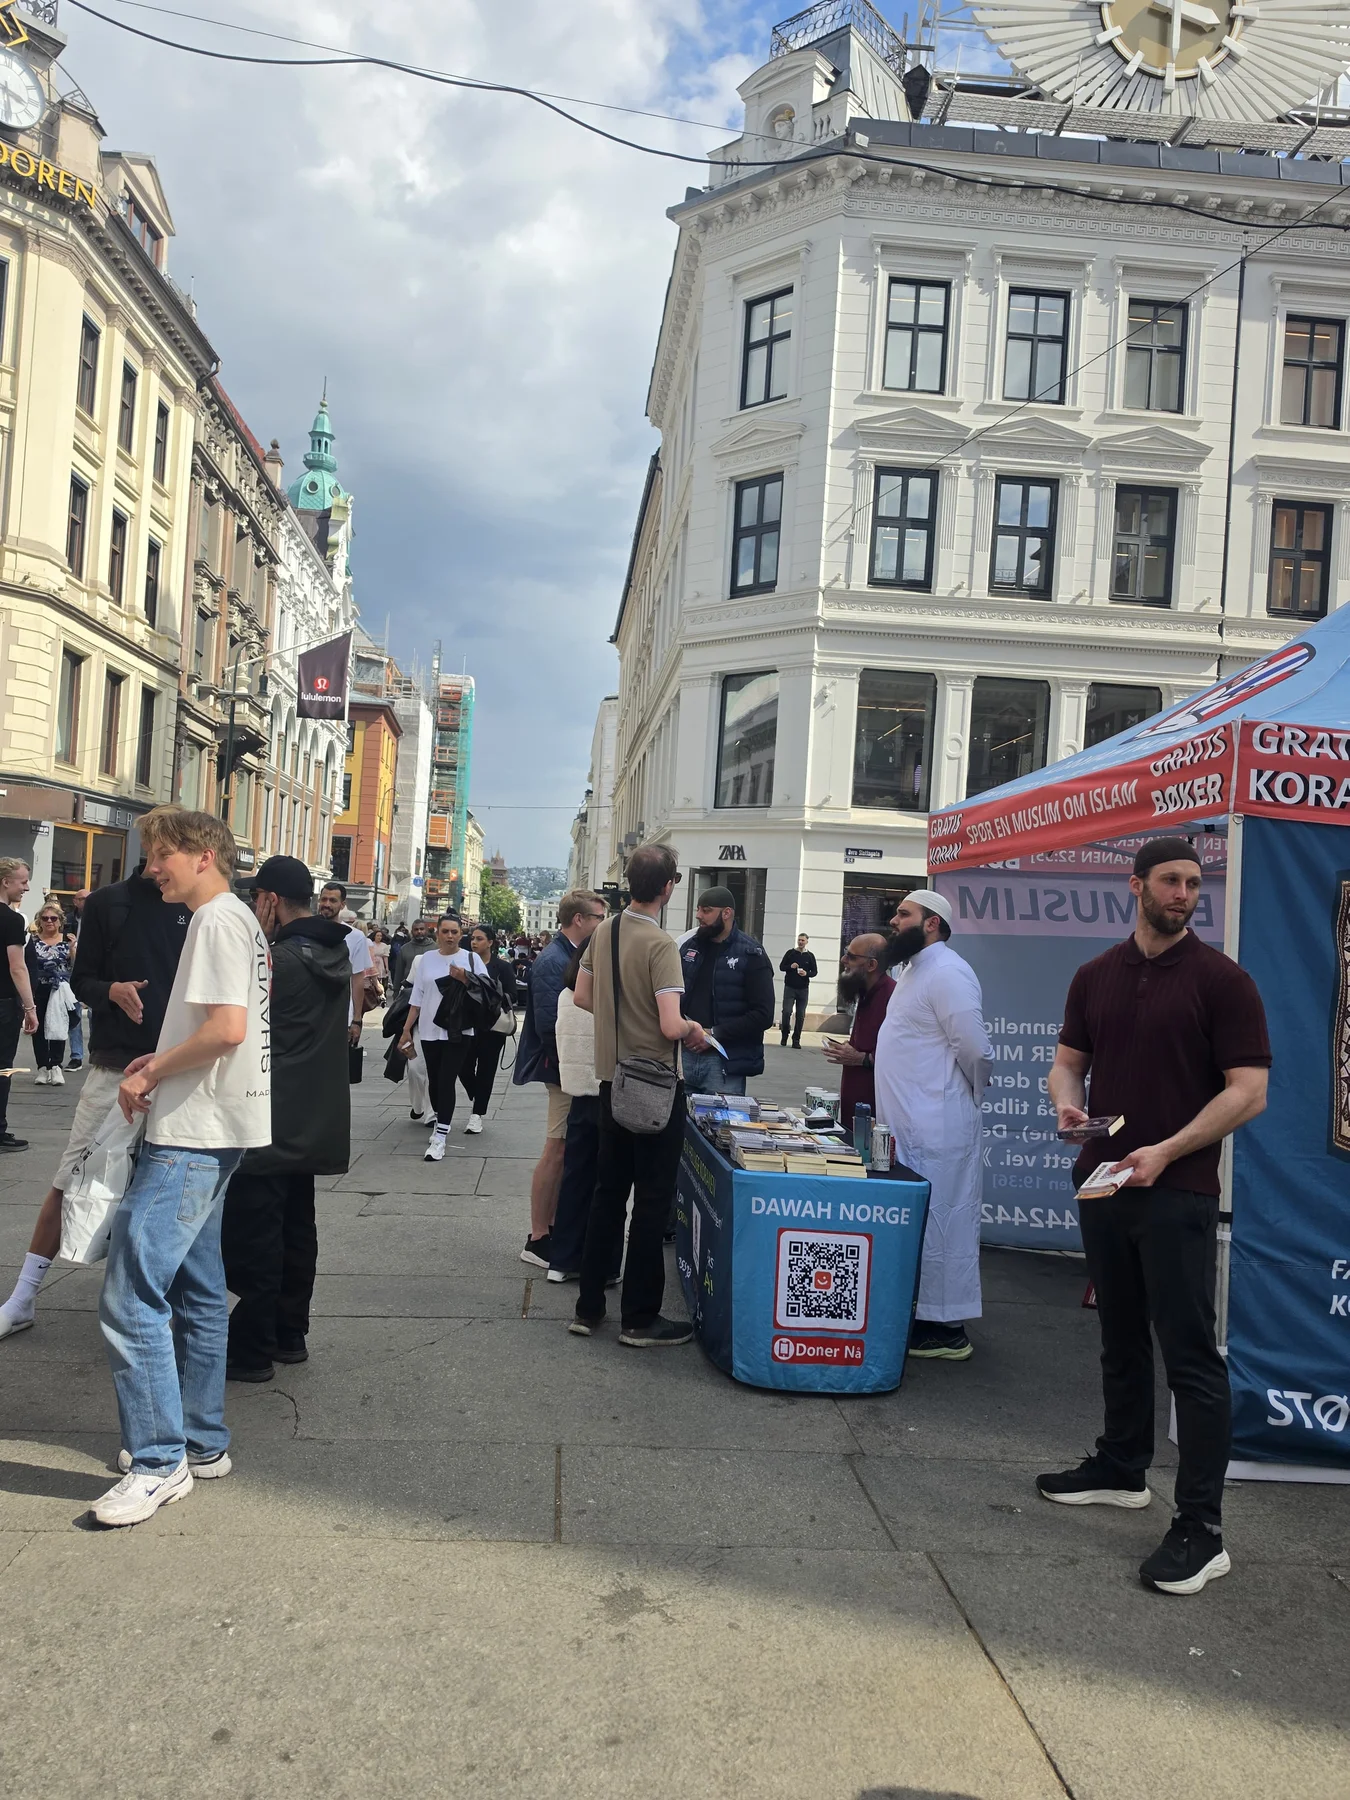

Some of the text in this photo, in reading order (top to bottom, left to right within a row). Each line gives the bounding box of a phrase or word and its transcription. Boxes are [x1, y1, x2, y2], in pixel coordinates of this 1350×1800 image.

[301, 691, 342, 703] lululemon
[1150, 728, 1227, 777] GRATIS
[1151, 773, 1224, 817] BØKER
[966, 820, 995, 845] SPØR
[994, 815, 1011, 838] EN
[1011, 800, 1061, 834] MUSLIM
[1063, 792, 1088, 820] OM
[1089, 779, 1139, 814] ISLAM
[931, 813, 963, 839] GRATIS
[718, 844, 747, 861] ZARA
[751, 1196, 911, 1225] DAWAH NORGE
[1331, 1259, 1350, 1280] F
[795, 1343, 862, 1359] Doner Nå
